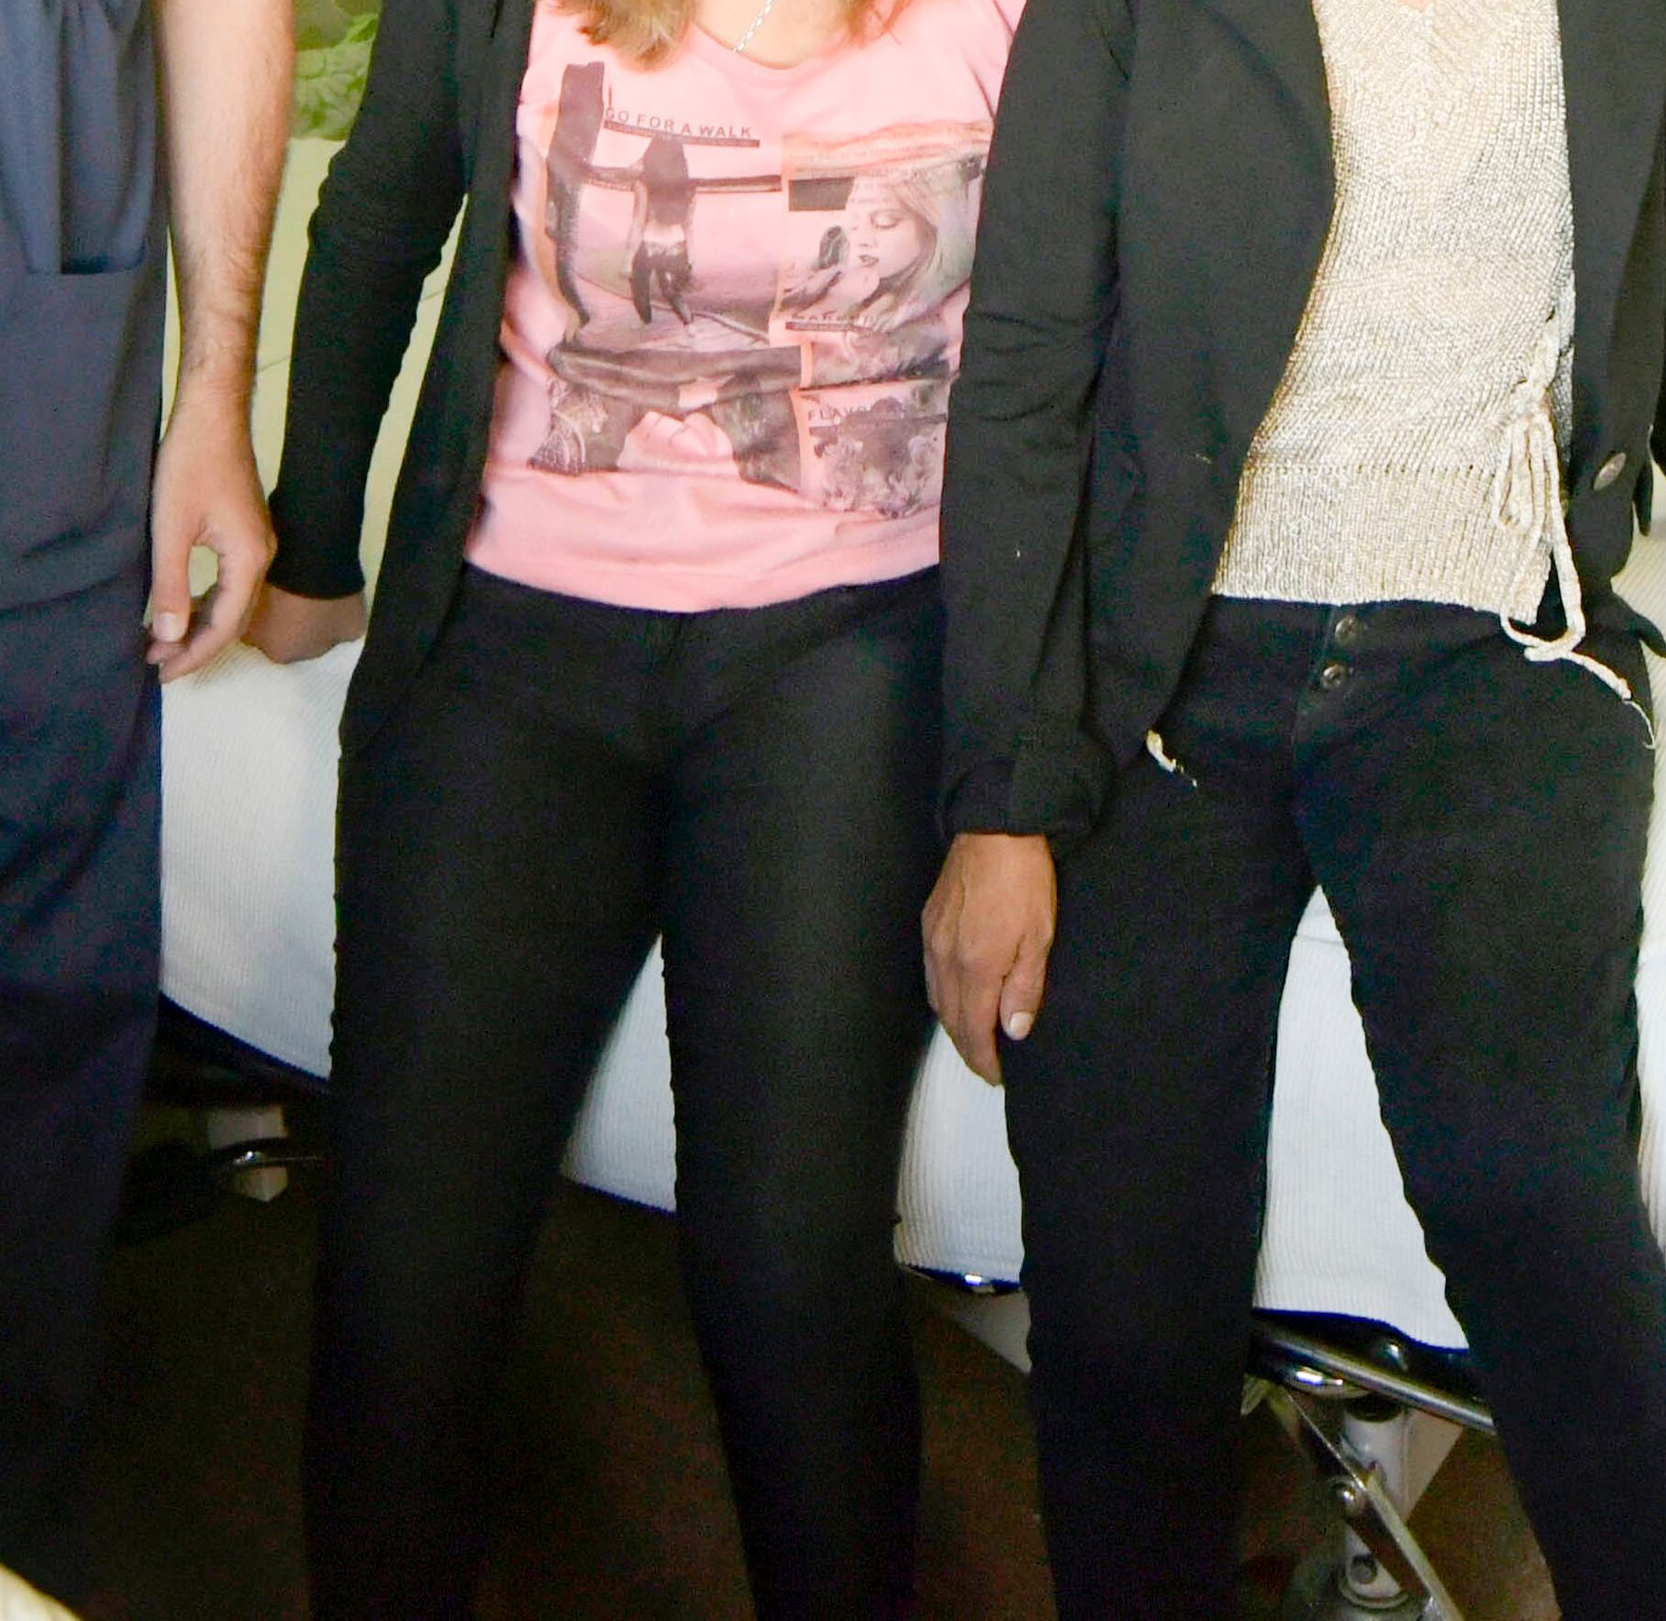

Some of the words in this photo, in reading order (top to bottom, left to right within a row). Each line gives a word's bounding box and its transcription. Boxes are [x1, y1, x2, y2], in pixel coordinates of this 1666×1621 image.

[604, 107, 630, 124] GO
[636, 113, 676, 131] FOR
[680, 122, 692, 135] A
[698, 125, 752, 139] WALK
